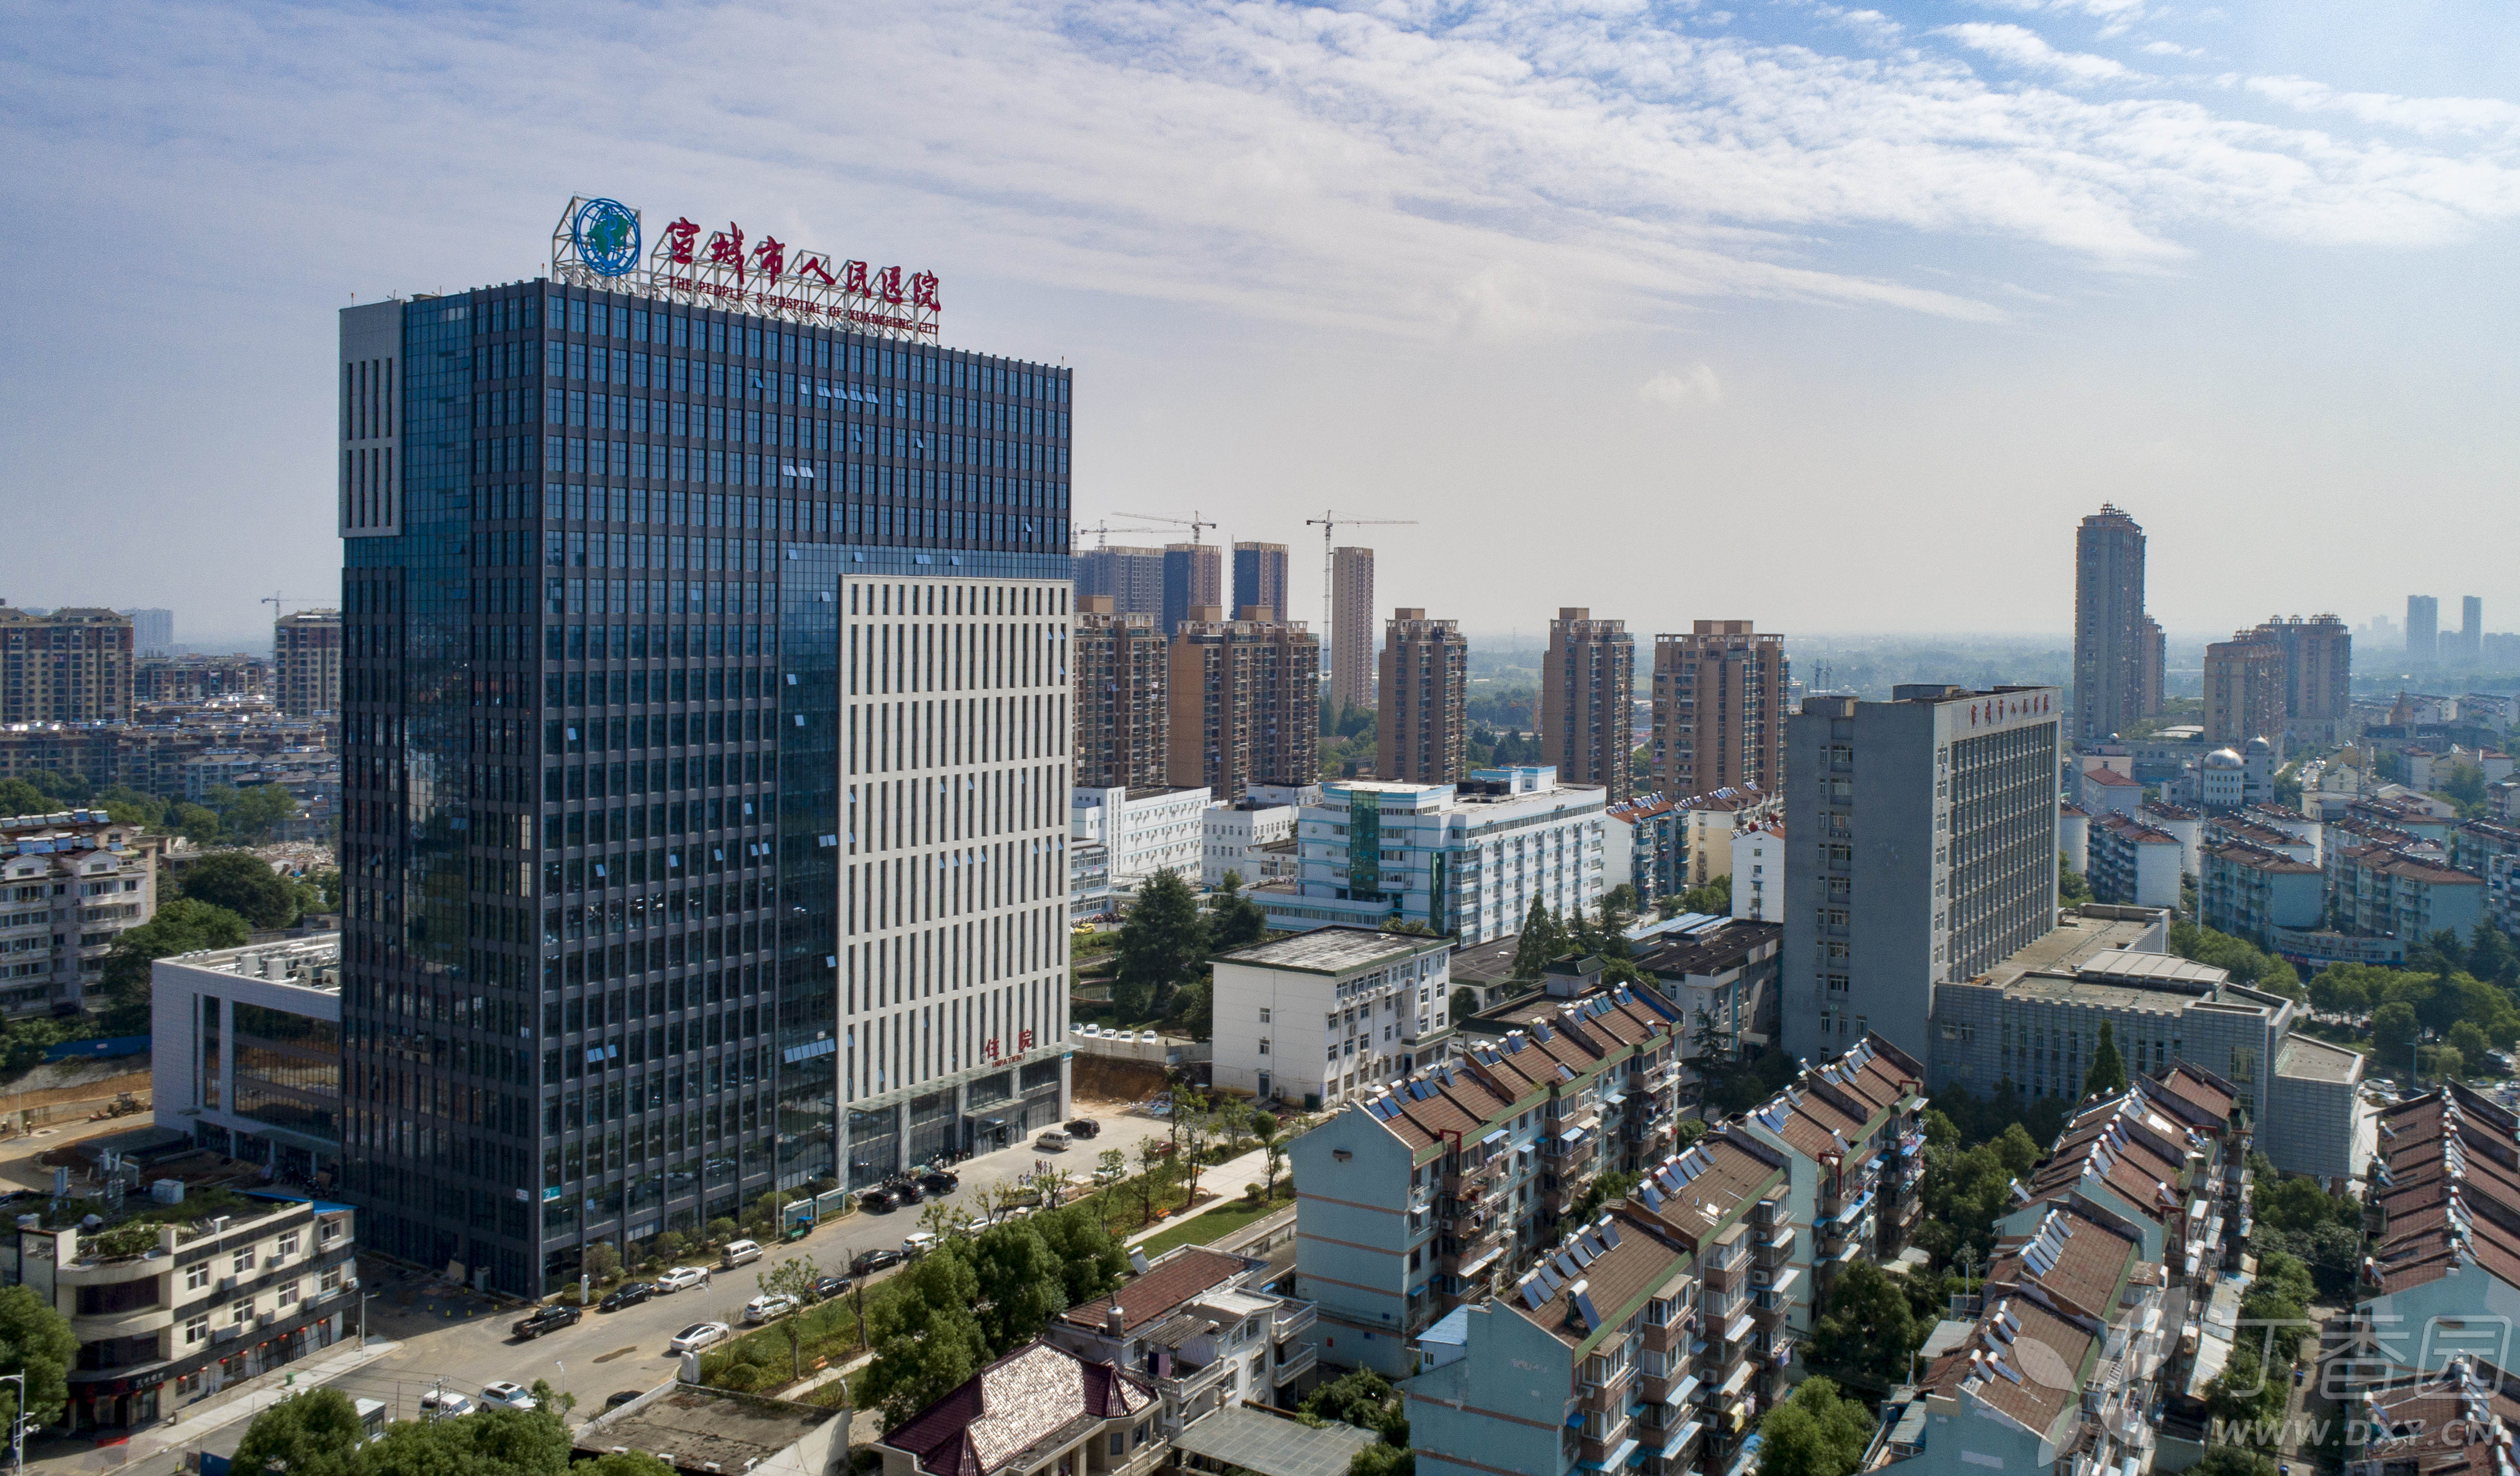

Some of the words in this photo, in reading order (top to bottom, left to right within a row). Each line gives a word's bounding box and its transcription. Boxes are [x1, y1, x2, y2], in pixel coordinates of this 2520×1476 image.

[666, 216, 941, 311] 宣城市人民医院
[669, 276, 693, 291] THE
[770, 295, 821, 314] HOSPITAL
[829, 306, 842, 317] OF
[849, 309, 913, 330] XUANCHENG
[918, 322, 939, 334] CITY
[986, 1029, 1032, 1059] 住院
[992, 1052, 1026, 1068] INPATIENT
